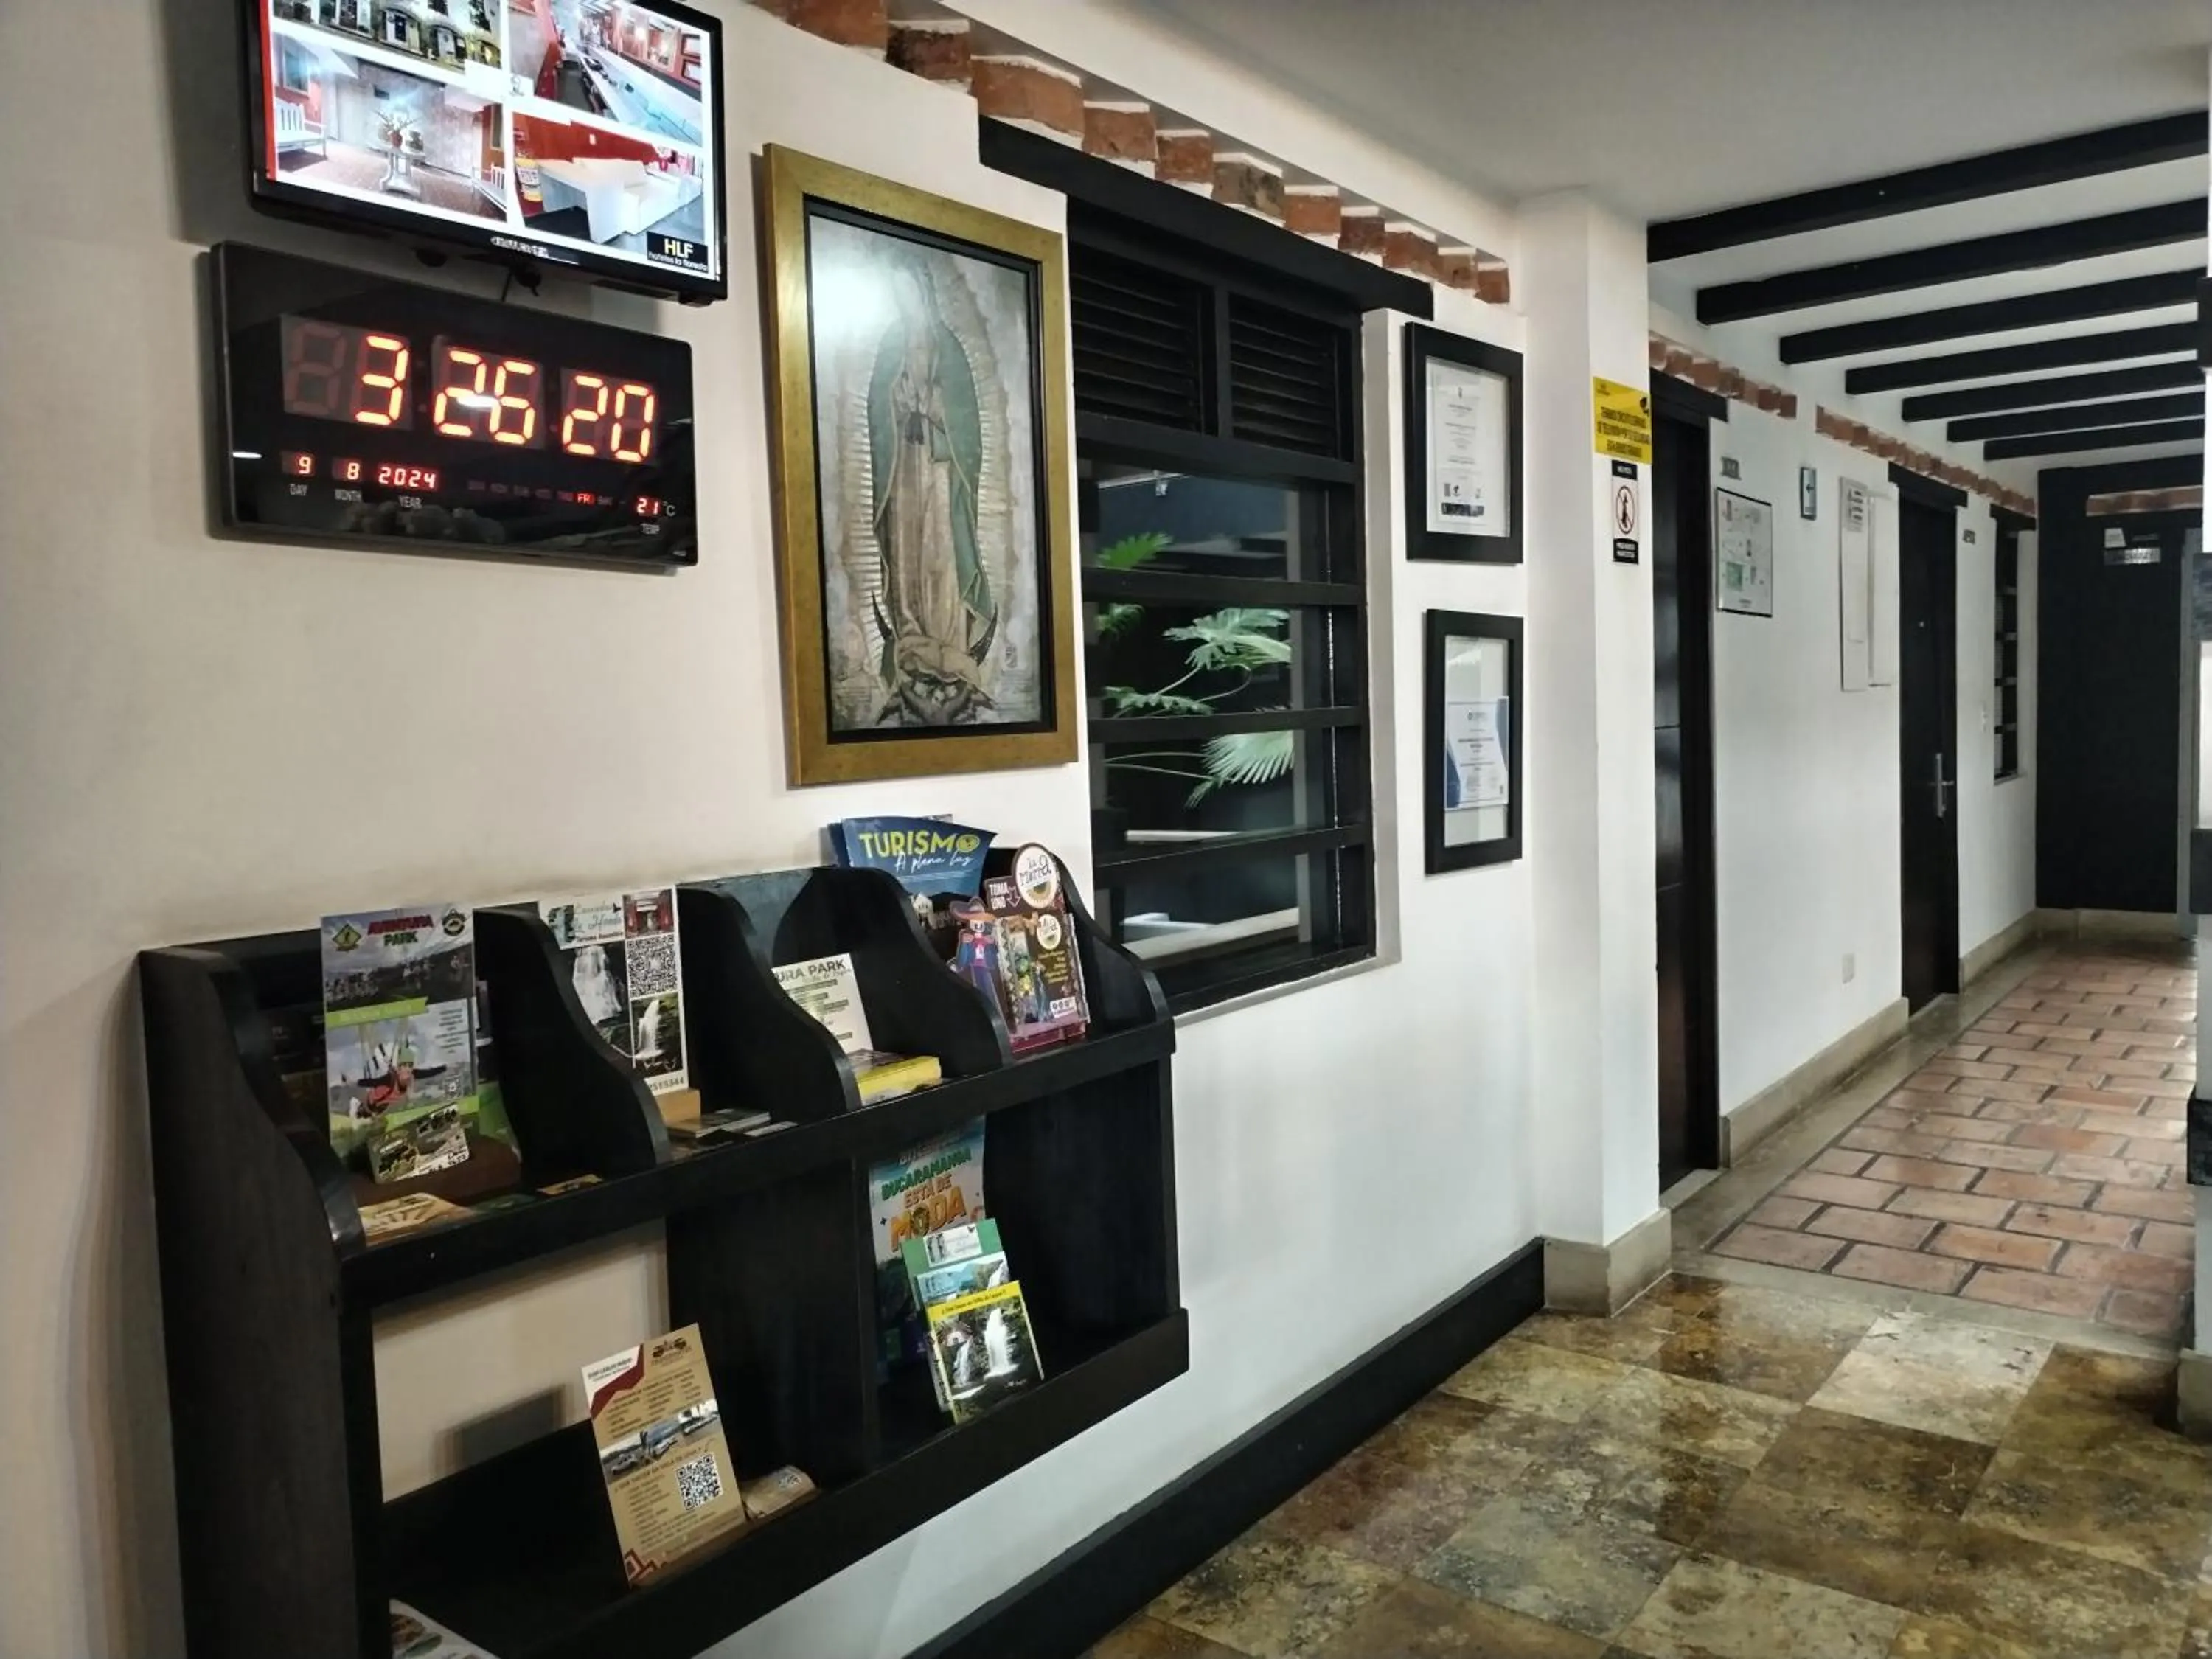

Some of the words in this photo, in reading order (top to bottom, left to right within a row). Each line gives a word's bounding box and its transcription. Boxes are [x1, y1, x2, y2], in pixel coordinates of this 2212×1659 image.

[664, 238, 694, 259] HLF
[355, 335, 410, 426] 3
[432, 349, 536, 445] 26
[562, 375, 655, 463] 20
[299, 456, 312, 474] 9
[347, 462, 361, 480] 8
[378, 467, 437, 488] 2024
[289, 483, 307, 496] DAY
[399, 495, 422, 509] YEAR
[636, 497, 659, 515] 21
[858, 830, 980, 859] TURISMO
[808, 959, 846, 975] PARK
[889, 1185, 967, 1253] MODA
